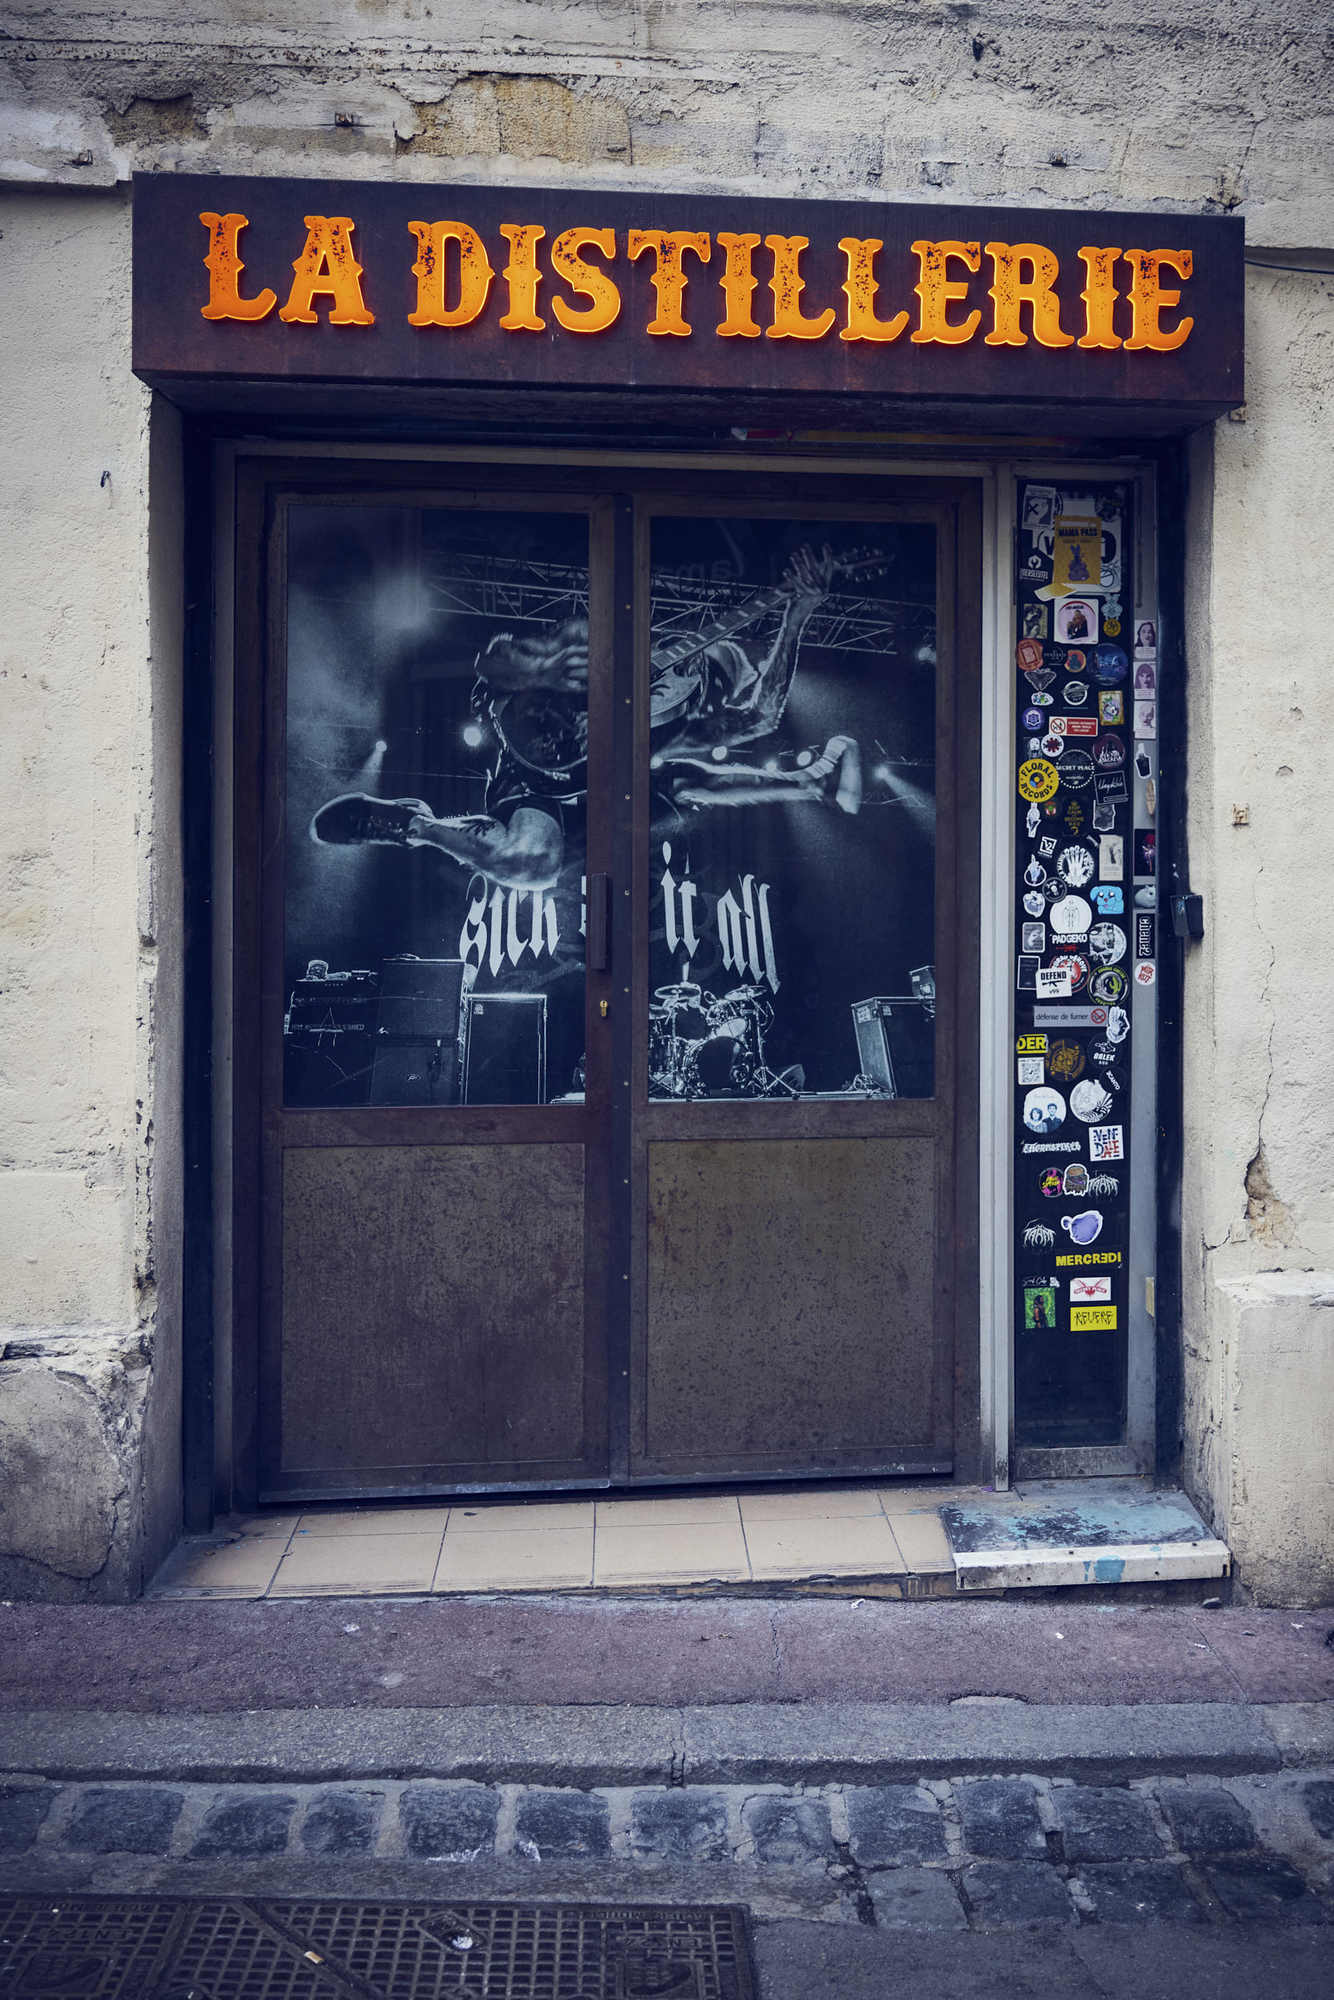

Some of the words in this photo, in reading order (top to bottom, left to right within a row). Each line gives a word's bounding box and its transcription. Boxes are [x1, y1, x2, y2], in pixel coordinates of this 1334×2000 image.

[199, 211, 375, 325] LA
[407, 220, 1195, 351] DISTILLERIE
[1021, 761, 1055, 779] FLORAL
[1020, 782, 1053, 799] RECORDS
[660, 841, 700, 958] it
[717, 872, 781, 994] all
[1040, 970, 1067, 981] DEFEND
[1036, 1012, 1060, 1021] défense
[1060, 1012, 1069, 1021] de
[1070, 1012, 1088, 1021] fumer
